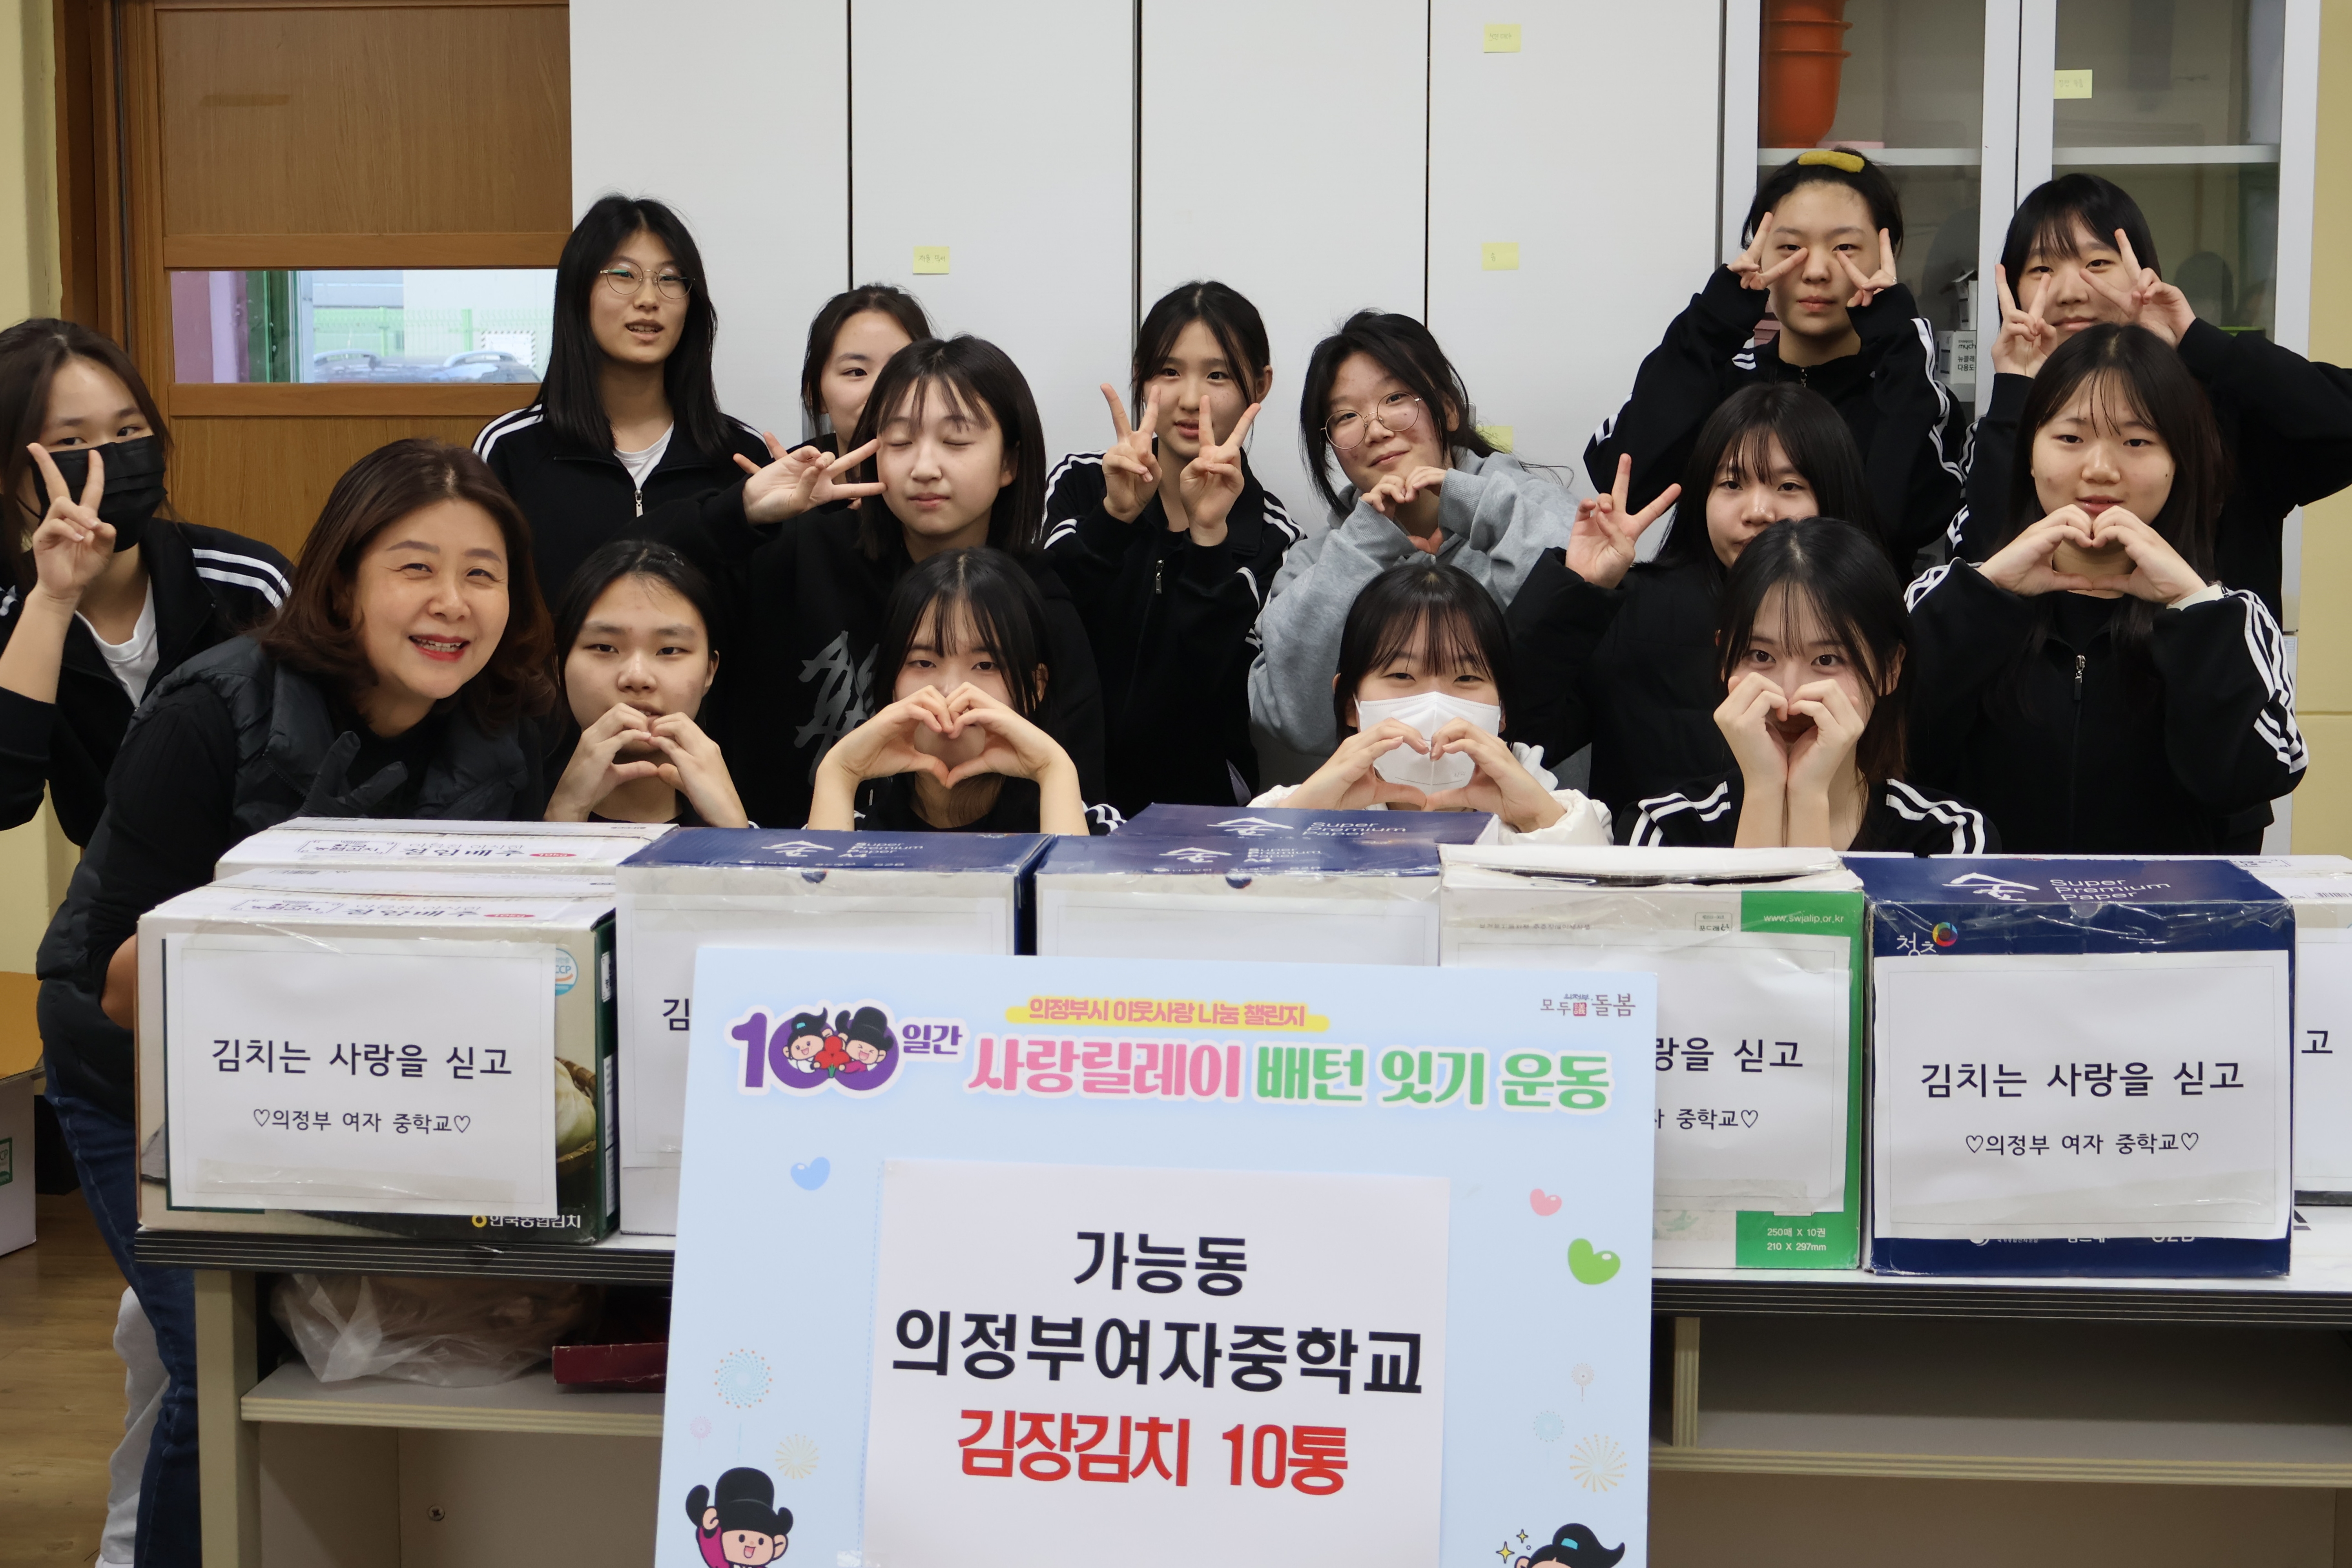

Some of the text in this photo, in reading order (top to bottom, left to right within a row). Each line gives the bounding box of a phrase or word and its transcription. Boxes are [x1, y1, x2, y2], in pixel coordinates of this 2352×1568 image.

[400, 848, 525, 857] 절임배추
[2050, 879, 2127, 887] Super
[2055, 883, 2171, 894] Premium
[2060, 892, 2138, 901] Paper
[1763, 914, 1844, 924] www.swjalip.or.kr
[662, 998, 689, 1031] 김
[1029, 998, 1305, 1027] 의정부시 이웃사랑 나눔 챌린지
[1540, 999, 1571, 1016] 모두
[1591, 993, 1636, 1017] 돌봄
[2301, 1030, 2333, 1054] 고
[212, 1039, 512, 1080] 김치는 사랑을 싣고
[1734, 1039, 1803, 1072] 싣고
[968, 1038, 1609, 1110] 사랑릴레이 배턴 잇기 운동
[1920, 1061, 2244, 1098] 김치는 사랑을 싣고
[272, 1110, 452, 1135] 의정부 여자 중학교
[1676, 1108, 1739, 1129] 중학교
[1985, 1132, 2179, 1156] 의정부 여자 중학교
[1767, 1227, 1826, 1238] 250매 X 10권
[1767, 1242, 1782, 1251] 210
[1796, 1242, 1827, 1251] 297mm
[1074, 1231, 1248, 1296] 가능동
[893, 1309, 1422, 1395] 의정부여자중학교
[957, 1409, 1349, 1496] 김장김치 10통
